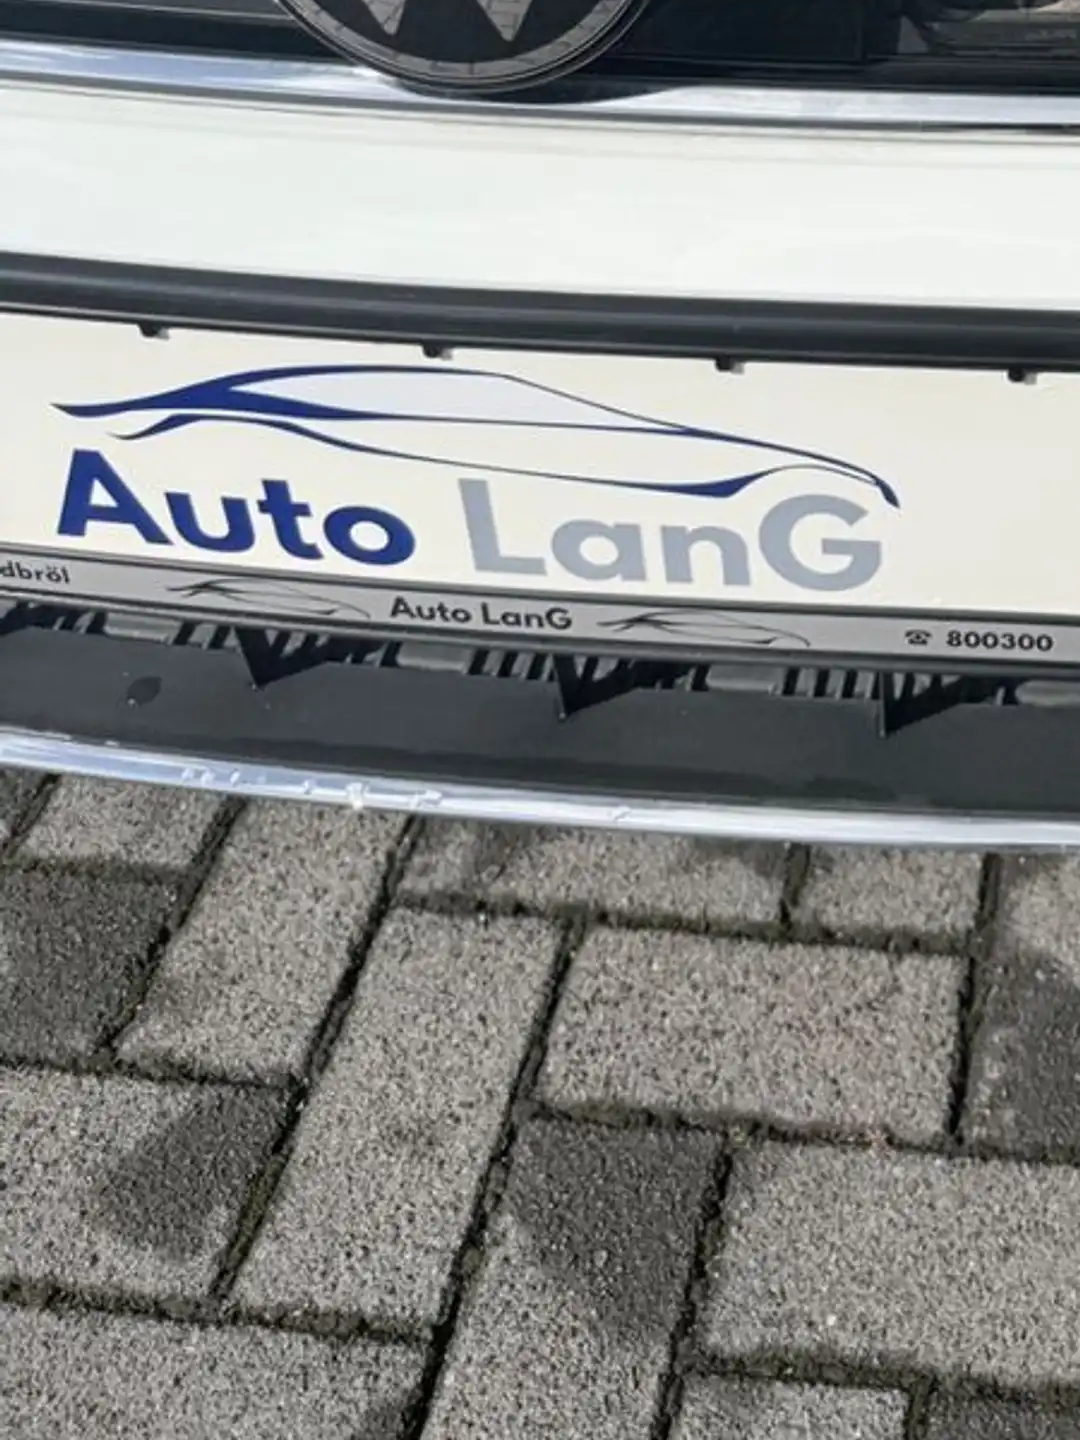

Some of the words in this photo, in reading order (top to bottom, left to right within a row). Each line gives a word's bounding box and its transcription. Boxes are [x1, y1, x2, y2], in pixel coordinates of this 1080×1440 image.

[56, 449, 416, 566] Auto
[458, 478, 882, 591] LanG
[390, 595, 472, 624] Auto
[480, 601, 572, 630] LanG
[946, 629, 1054, 652] 800300
